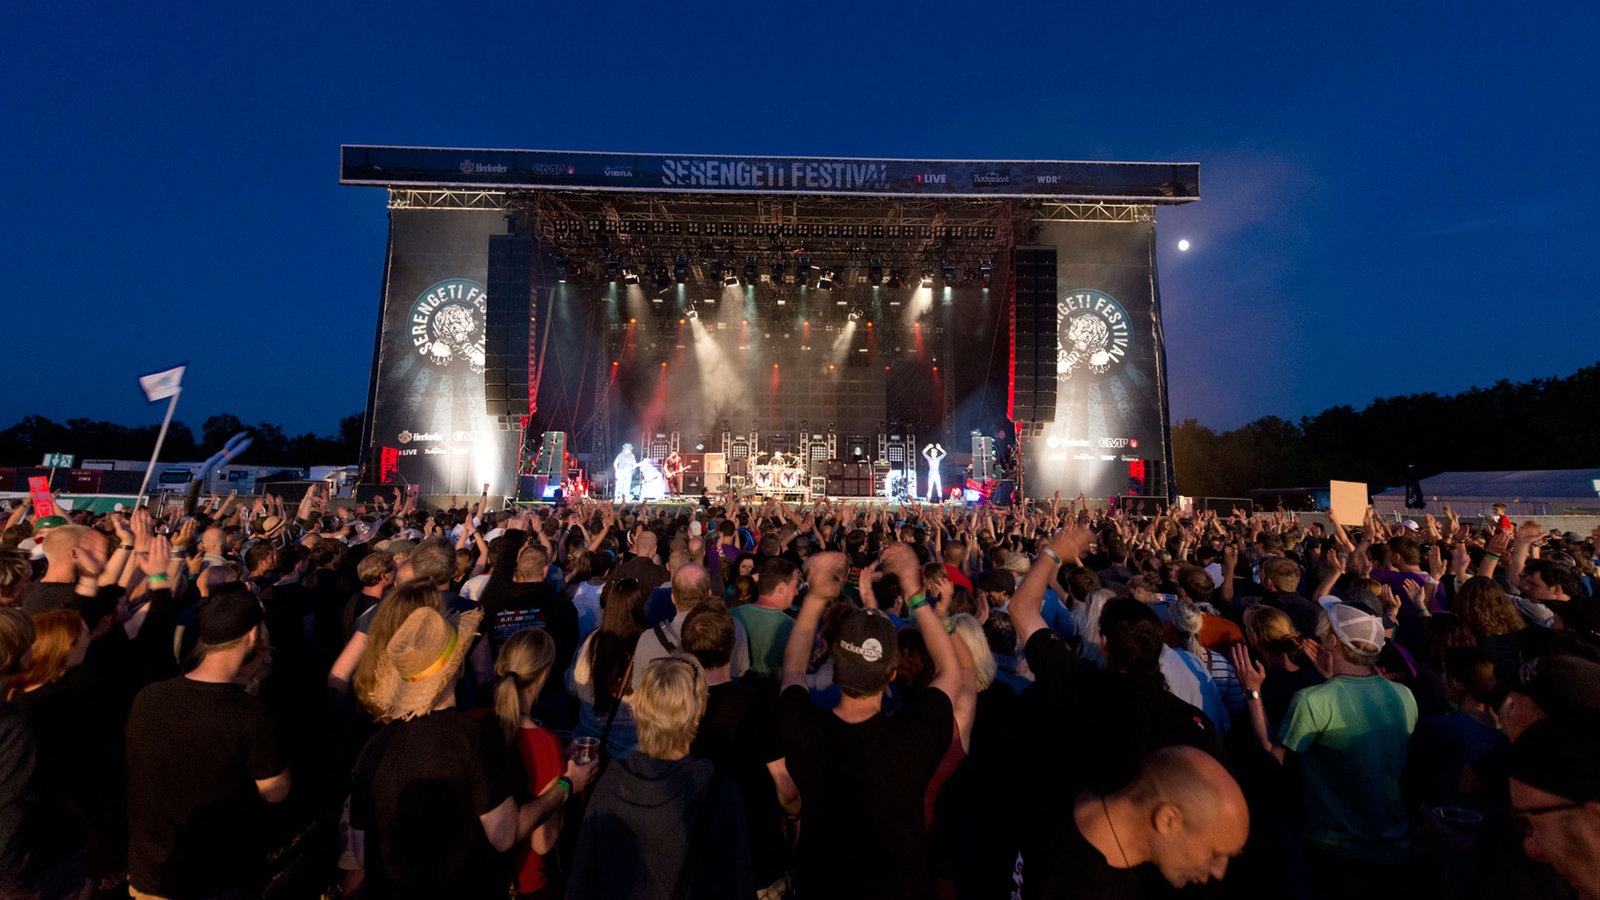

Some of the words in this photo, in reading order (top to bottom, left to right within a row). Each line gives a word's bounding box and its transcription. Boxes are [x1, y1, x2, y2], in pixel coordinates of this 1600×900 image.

[662, 159, 784, 187] SERENGETI
[791, 162, 890, 189] FESTIVAL
[412, 284, 463, 355] SERENGETI
[1095, 297, 1128, 363] FESTIVAL
